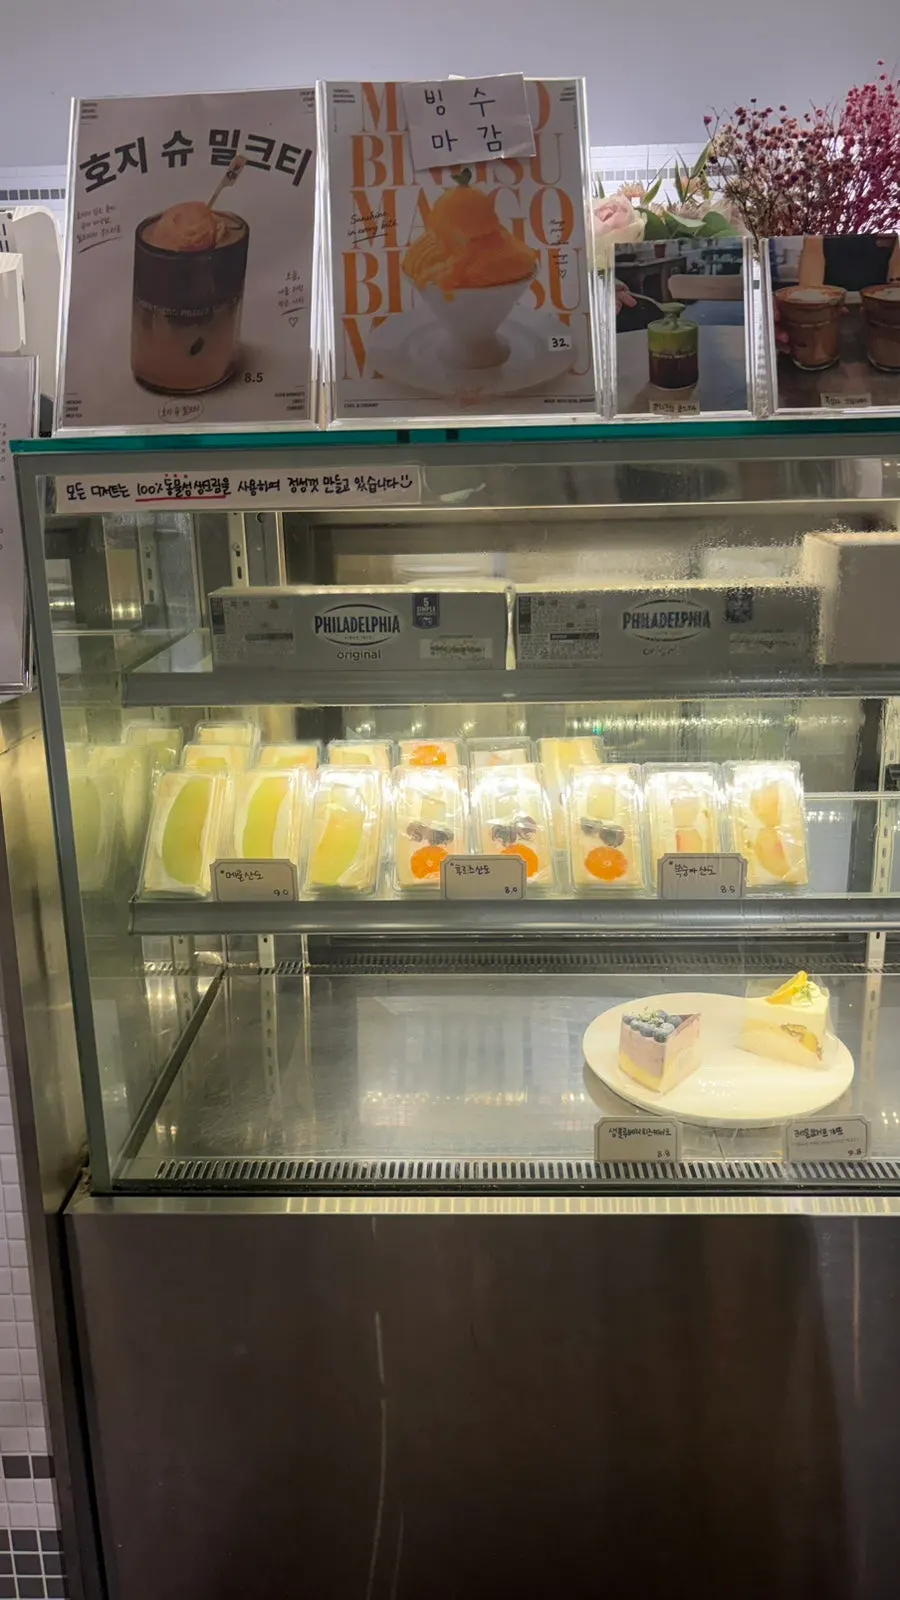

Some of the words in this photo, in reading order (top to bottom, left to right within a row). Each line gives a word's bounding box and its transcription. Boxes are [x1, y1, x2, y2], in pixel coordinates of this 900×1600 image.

[79, 136, 149, 194] 호지
[161, 129, 194, 169] 슈
[208, 128, 313, 188] 밀크티
[244, 372, 264, 383] 8.5
[66, 482, 87, 500] 모든
[90, 482, 131, 498] 디저트는
[193, 477, 232, 496] 생크림을
[237, 478, 281, 497] 사용하며
[287, 476, 319, 494] 정성껏
[322, 474, 350, 494] 만들고
[354, 474, 399, 494] 있습니다
[314, 615, 401, 634] PHILADELPHIA
[622, 609, 711, 630] PHILADELPHIA
[336, 649, 381, 661] original
